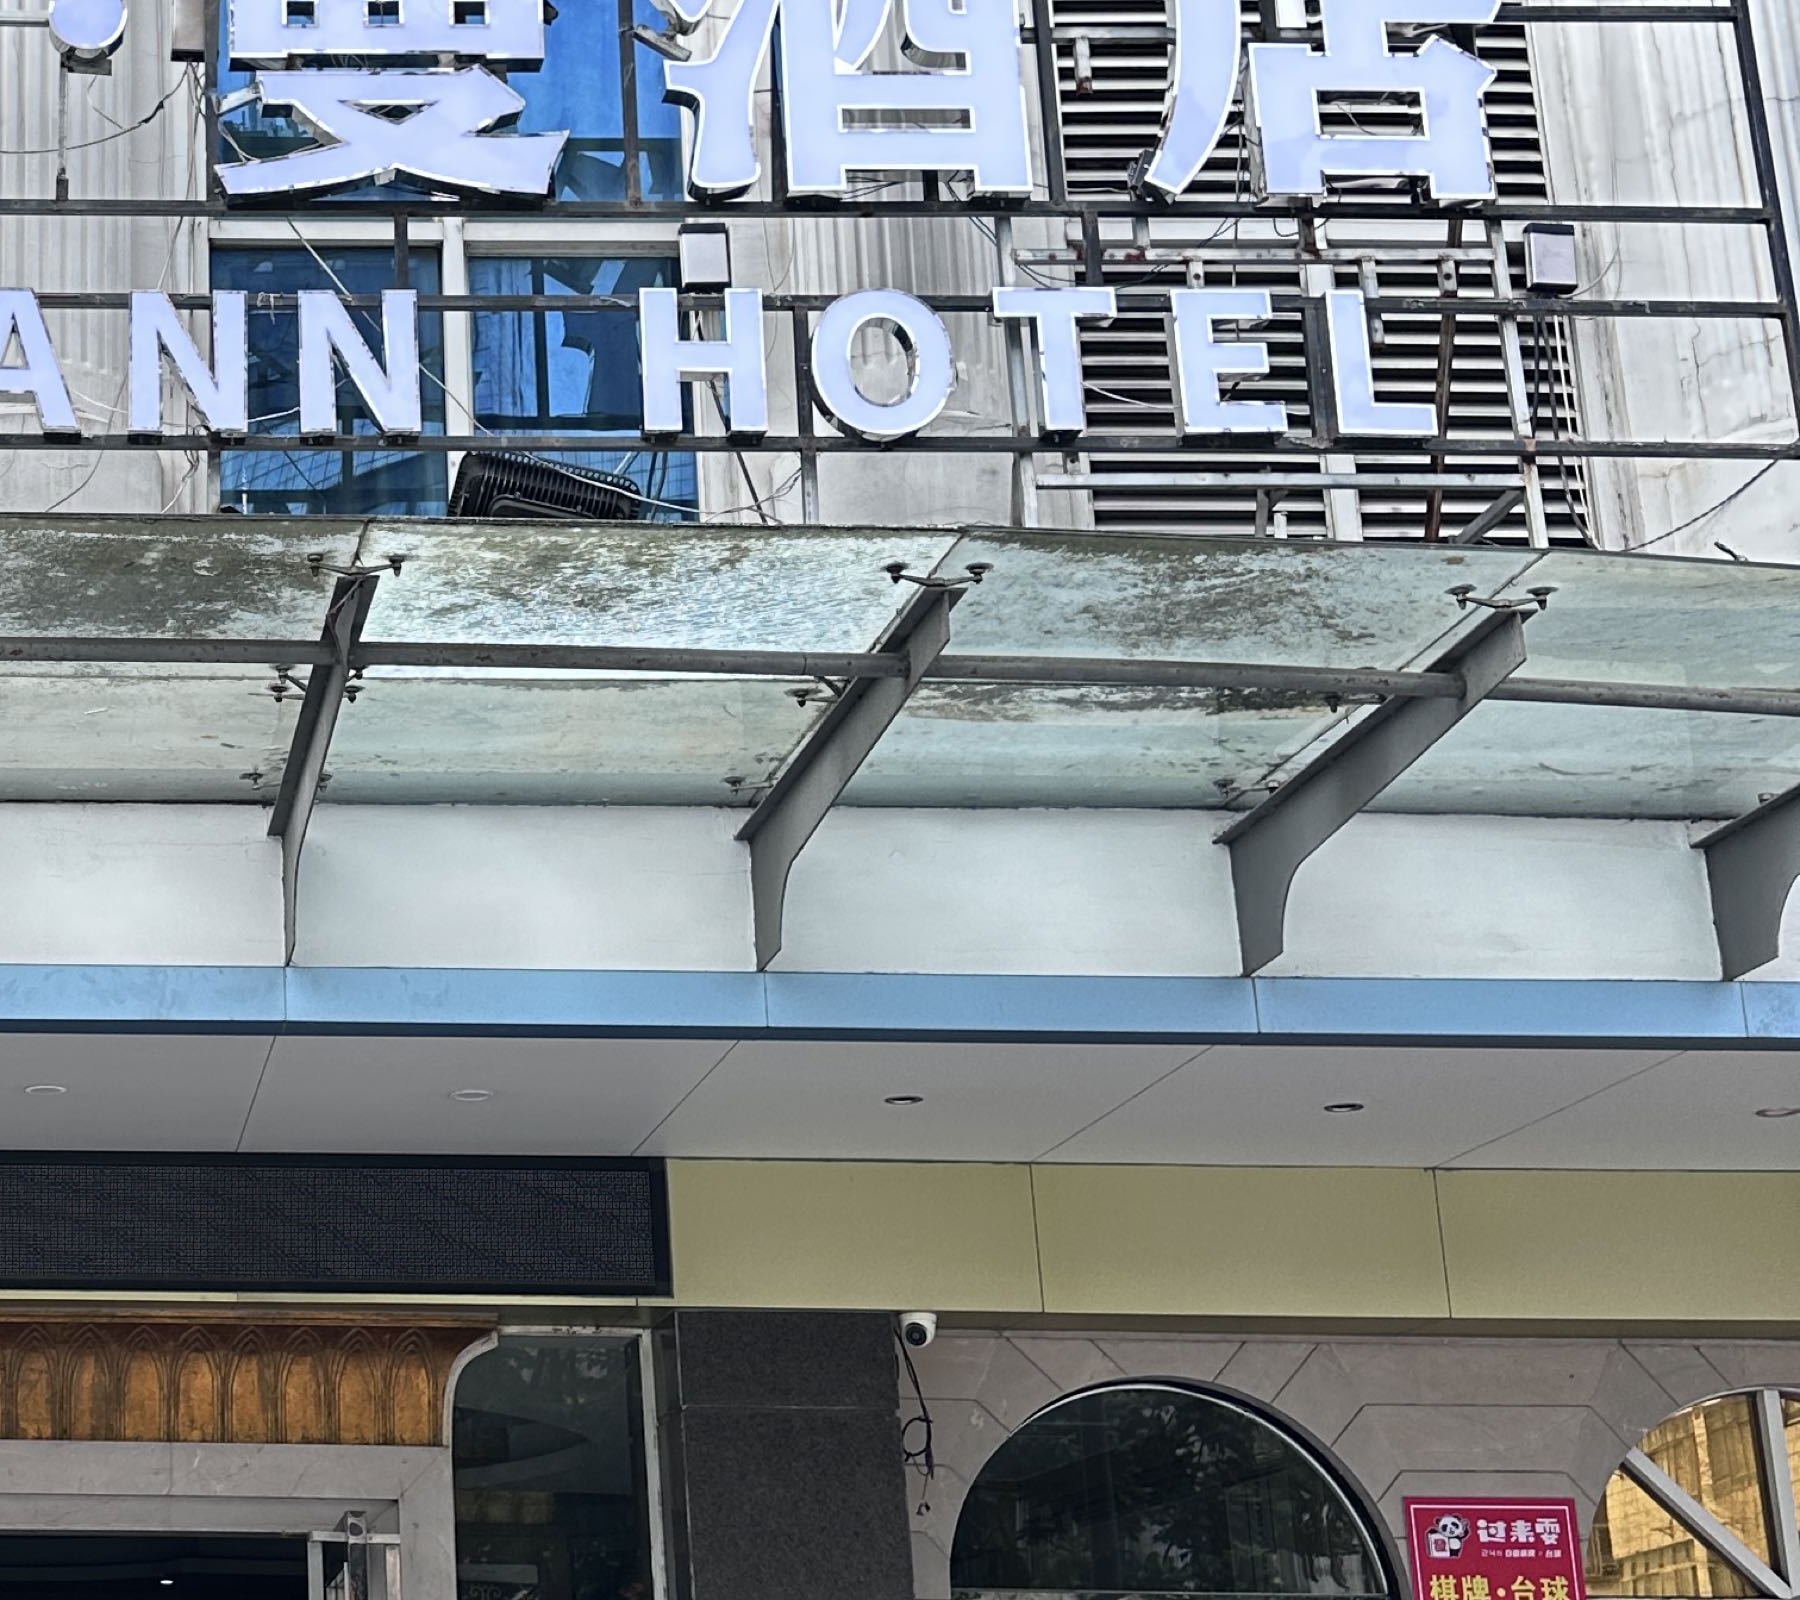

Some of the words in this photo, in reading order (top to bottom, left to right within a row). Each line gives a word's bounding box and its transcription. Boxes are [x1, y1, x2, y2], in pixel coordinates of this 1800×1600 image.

[638, 287, 1440, 439] HOTEL
[1476, 1517, 1561, 1546] 过来耍
